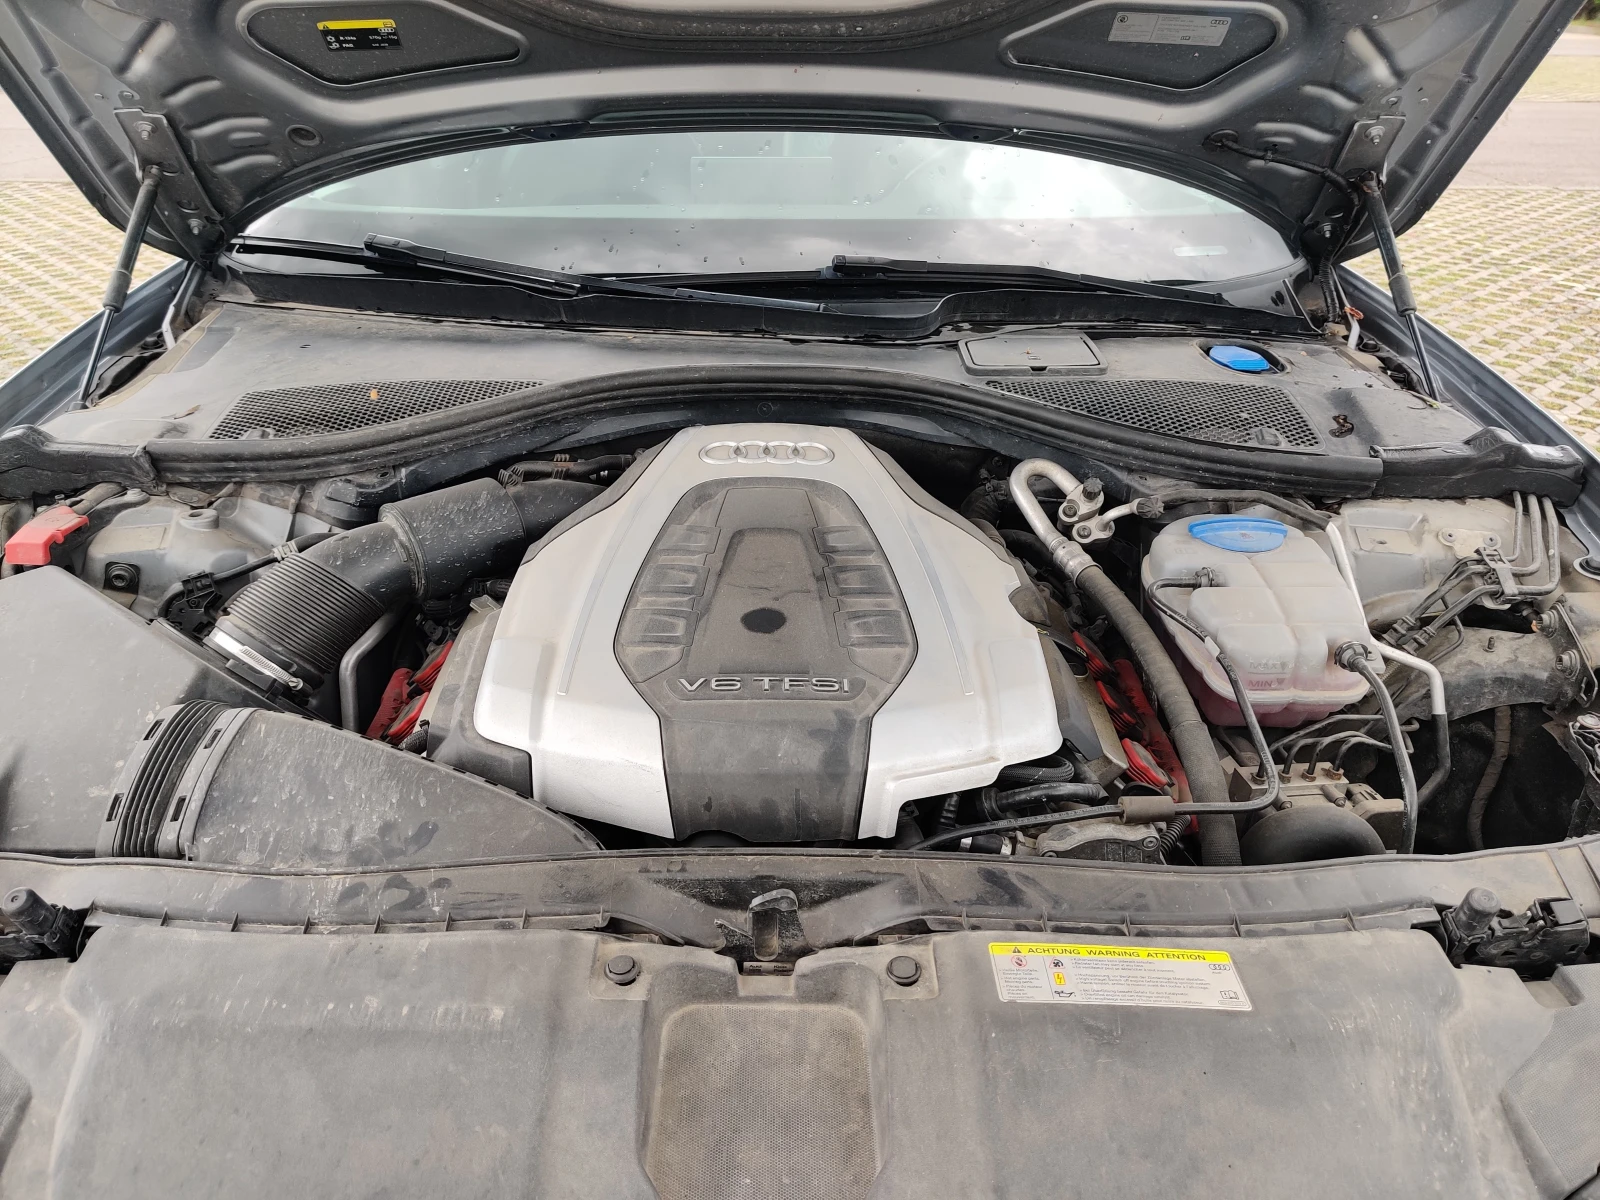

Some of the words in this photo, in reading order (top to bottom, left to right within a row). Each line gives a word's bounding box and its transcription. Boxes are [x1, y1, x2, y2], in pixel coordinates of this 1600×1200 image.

[678, 677, 742, 693] V6
[752, 677, 850, 694] TFSI
[1248, 680, 1273, 688] MIN
[1027, 947, 1080, 955] ACHTUNG
[1086, 949, 1140, 957] WARNING
[1146, 952, 1207, 961] ATTENTION
